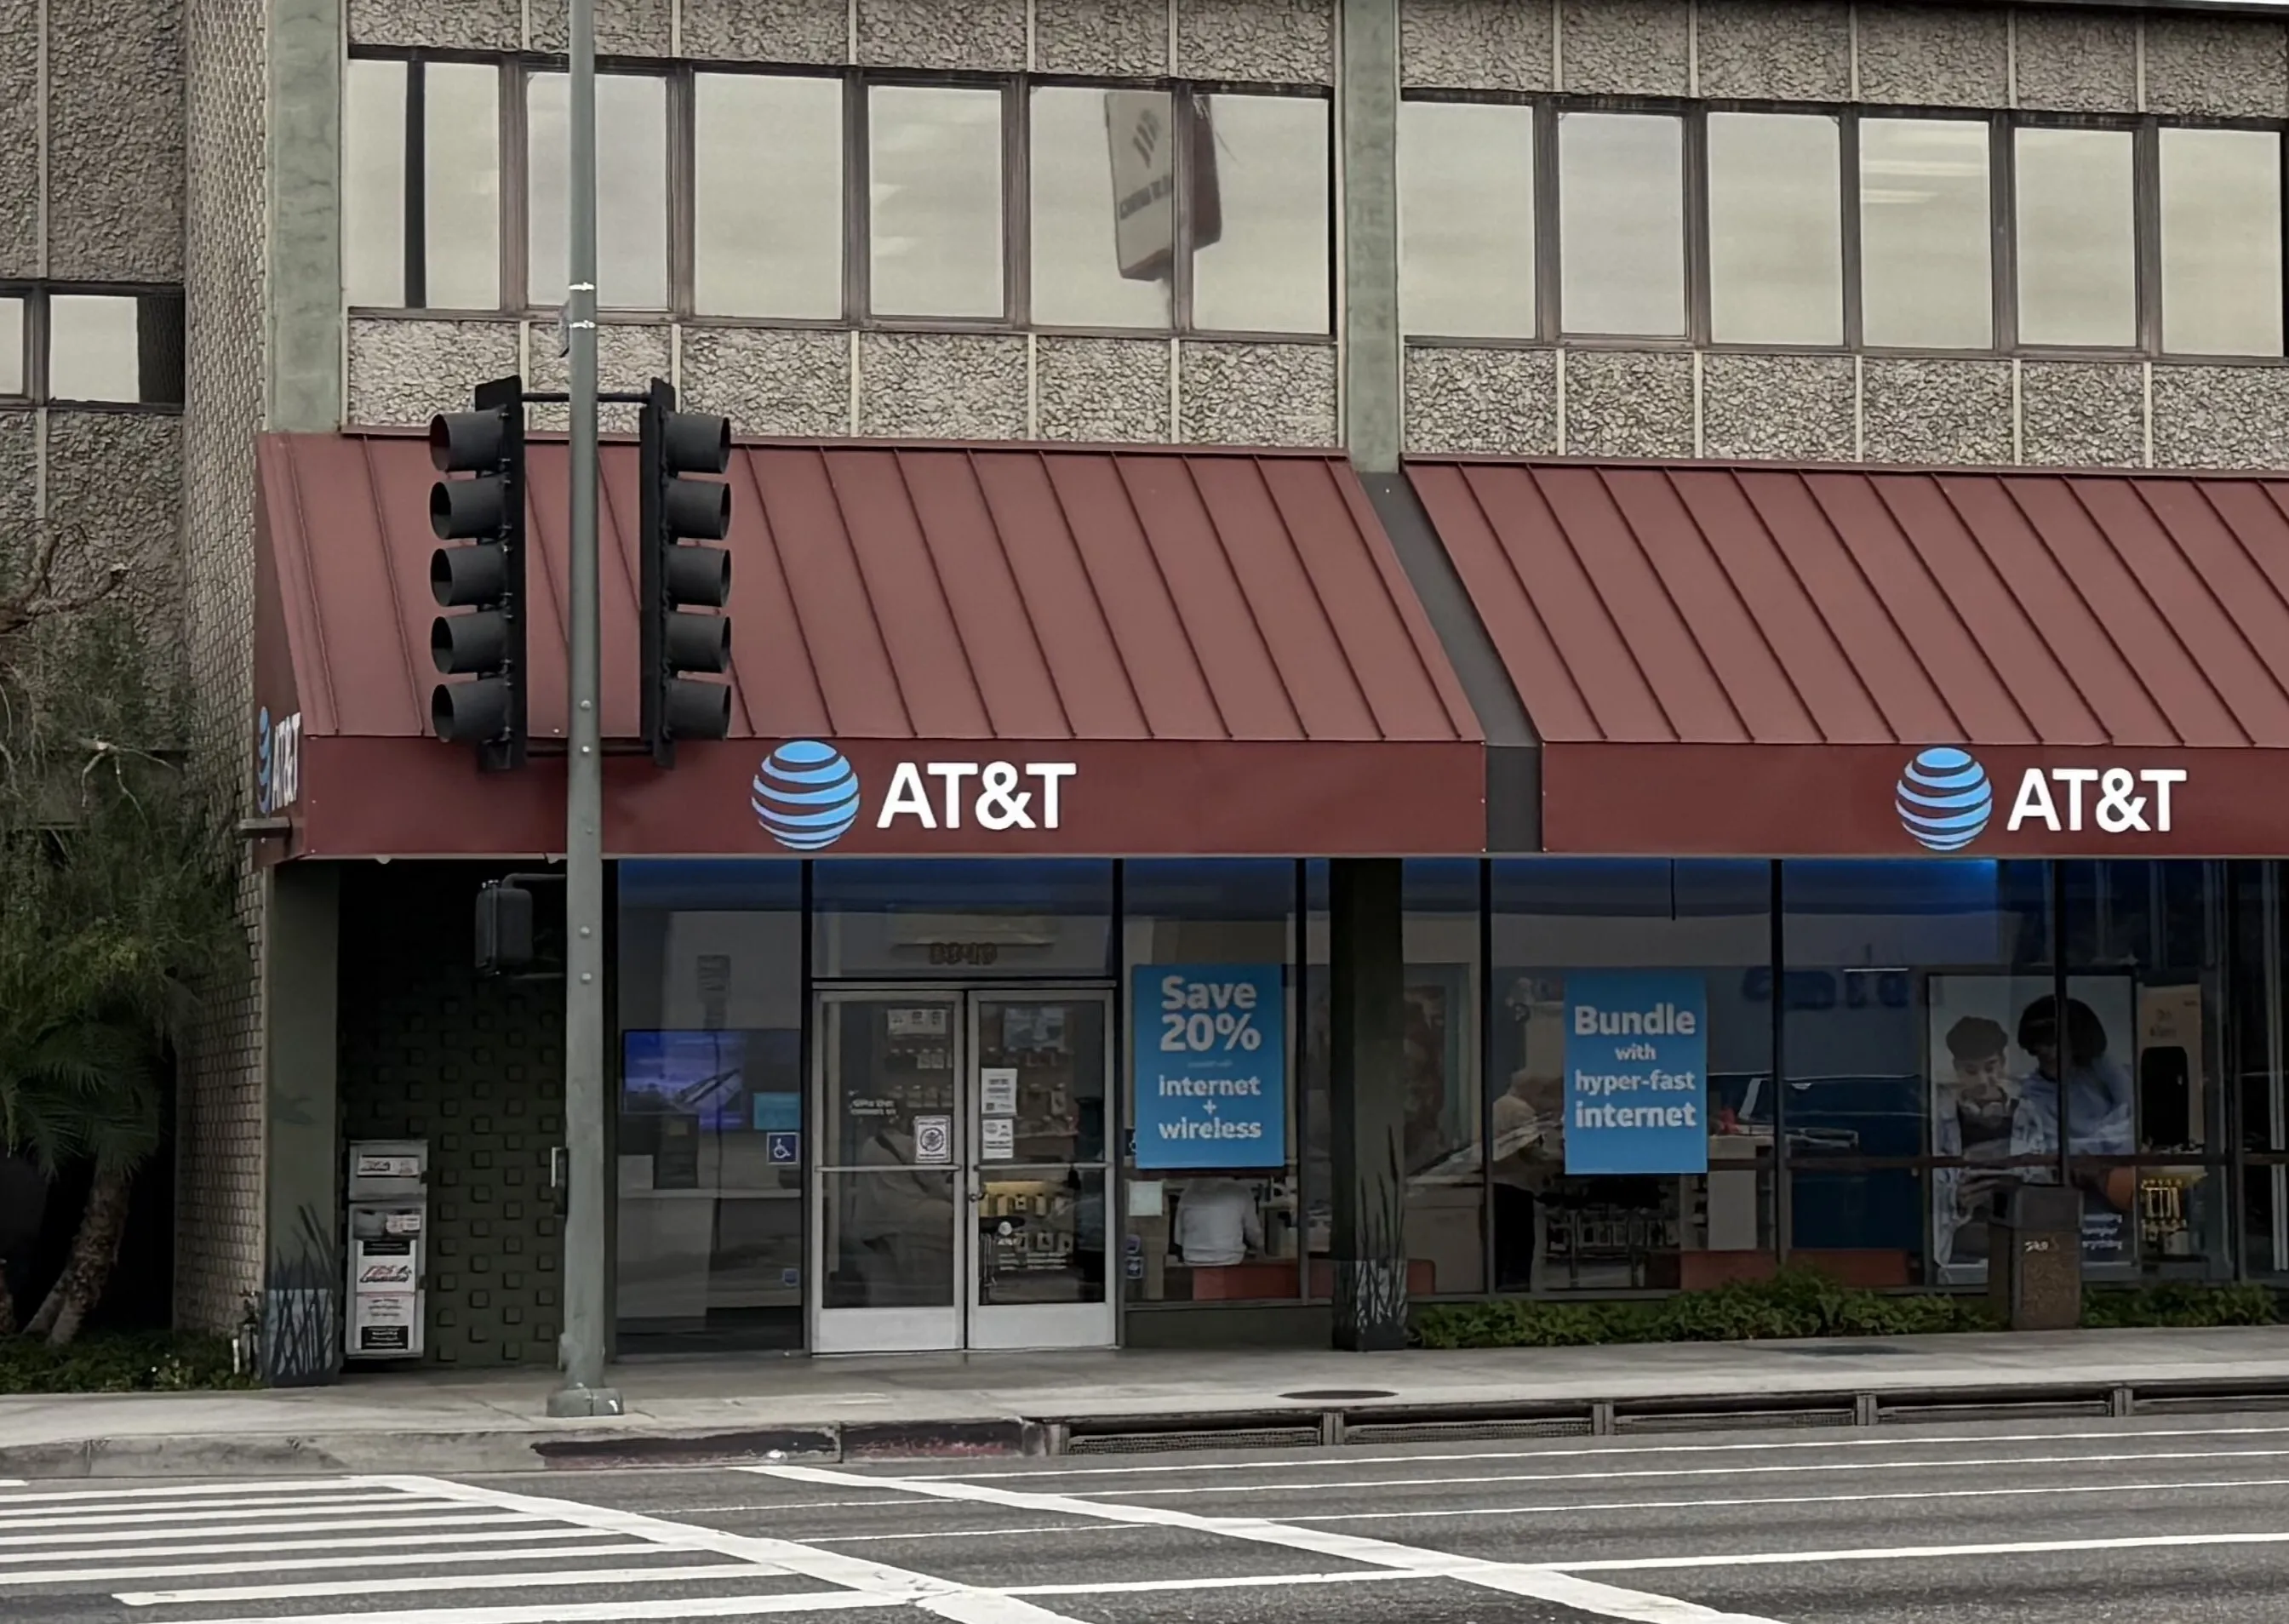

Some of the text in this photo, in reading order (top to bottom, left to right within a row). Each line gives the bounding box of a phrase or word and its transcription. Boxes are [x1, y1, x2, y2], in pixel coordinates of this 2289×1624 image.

[876, 761, 1077, 831] AT&T
[2006, 767, 2187, 832] AT&T
[1161, 976, 1256, 1009] Save
[1159, 1013, 1261, 1051] 20%
[1575, 1004, 1695, 1035] Bundle
[1615, 1044, 1657, 1061] with
[1159, 1075, 1261, 1096] internet
[1575, 1069, 1695, 1095] hyper-fast
[1159, 1116, 1262, 1140] wireless
[1576, 1101, 1697, 1128] internet
